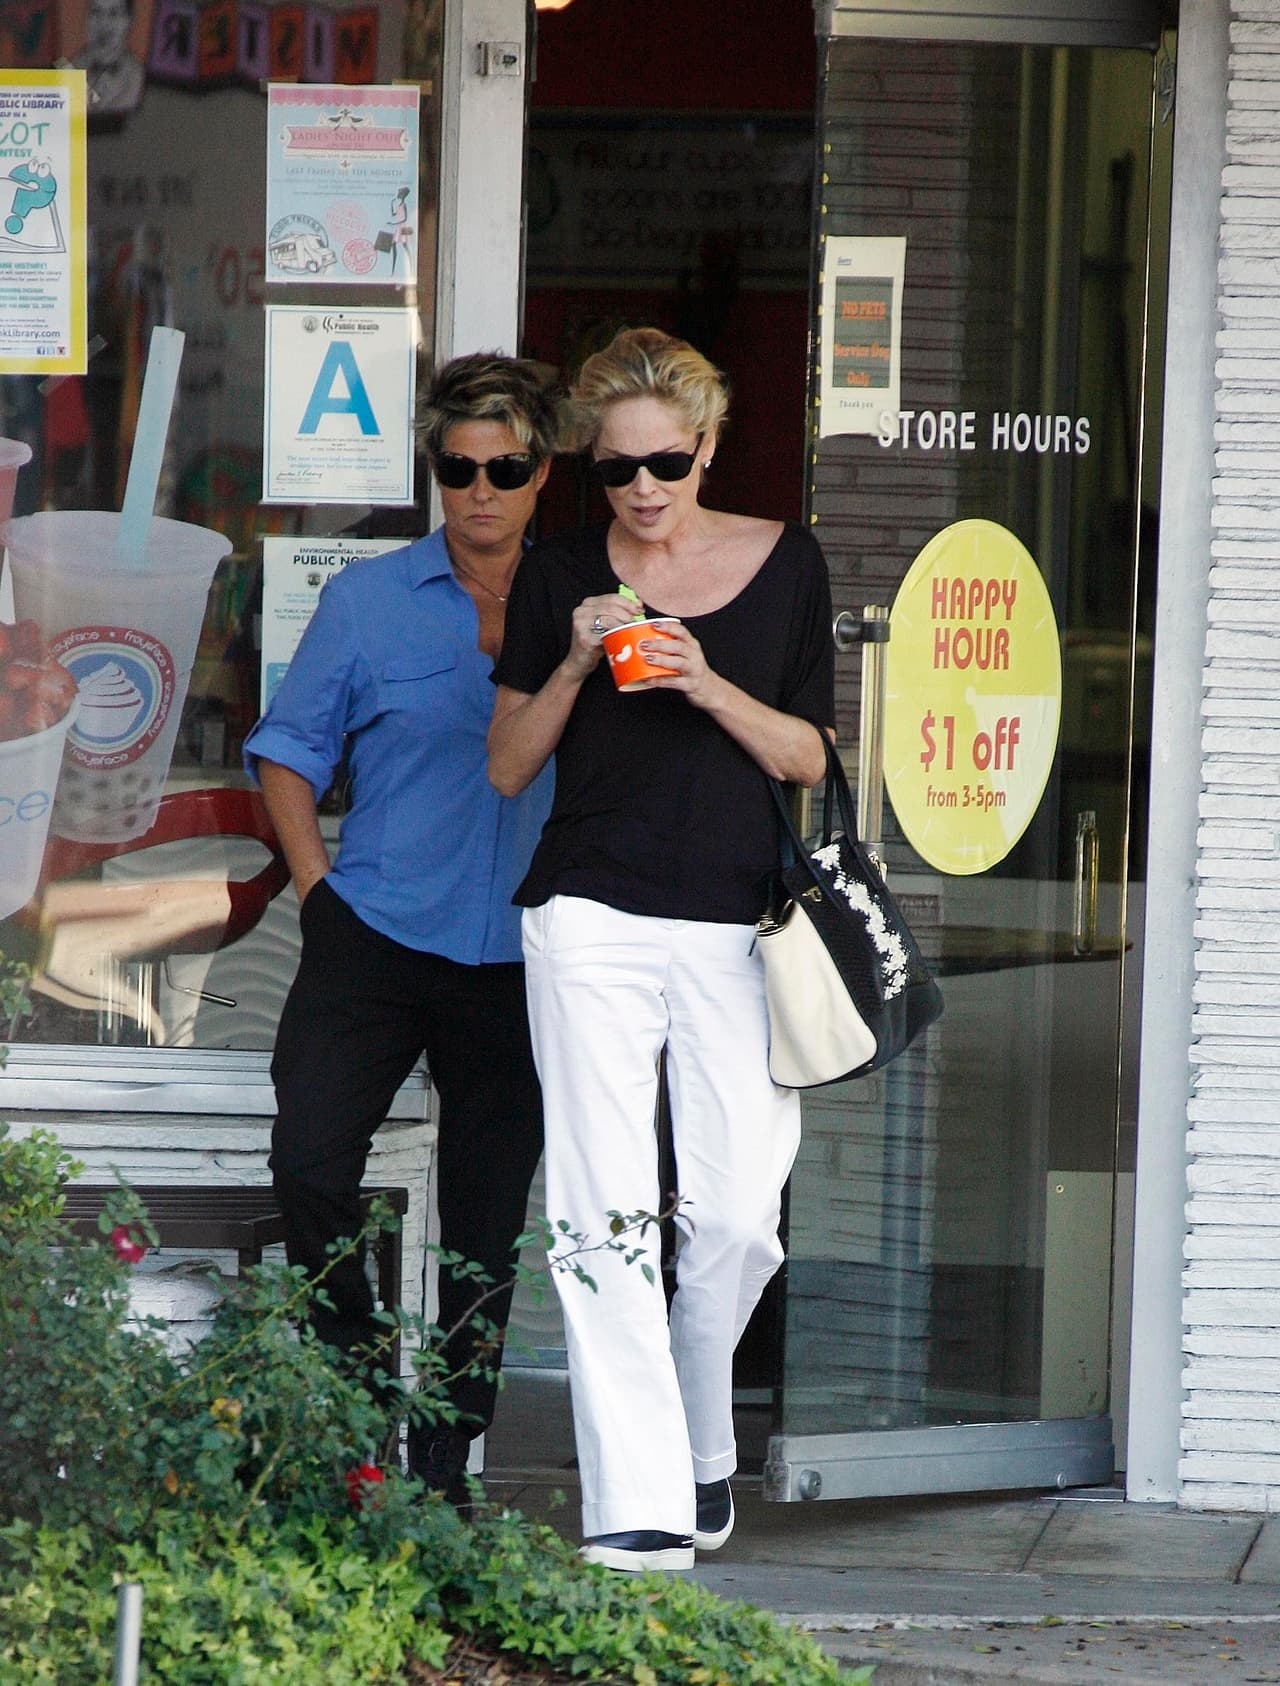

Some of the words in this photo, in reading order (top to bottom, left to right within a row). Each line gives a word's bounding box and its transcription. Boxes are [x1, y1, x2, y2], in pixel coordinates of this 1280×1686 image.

[22, 100, 65, 109] LIBRARY
[859, 301, 886, 316] PETS
[834, 342, 870, 357] Service
[297, 341, 381, 436] A
[846, 371, 870, 387] Only
[878, 410, 976, 450] STORE
[992, 411, 1091, 454] HOURS
[293, 555, 336, 566] PUBLIC
[299, 547, 354, 555] ENVIRONMENTAL
[931, 577, 1018, 621] HAPPY
[933, 627, 1010, 670] HOUR
[919, 709, 956, 773] $1
[971, 716, 1021, 771] off
[926, 784, 958, 808] from
[962, 784, 1007, 813] 3-5pm
